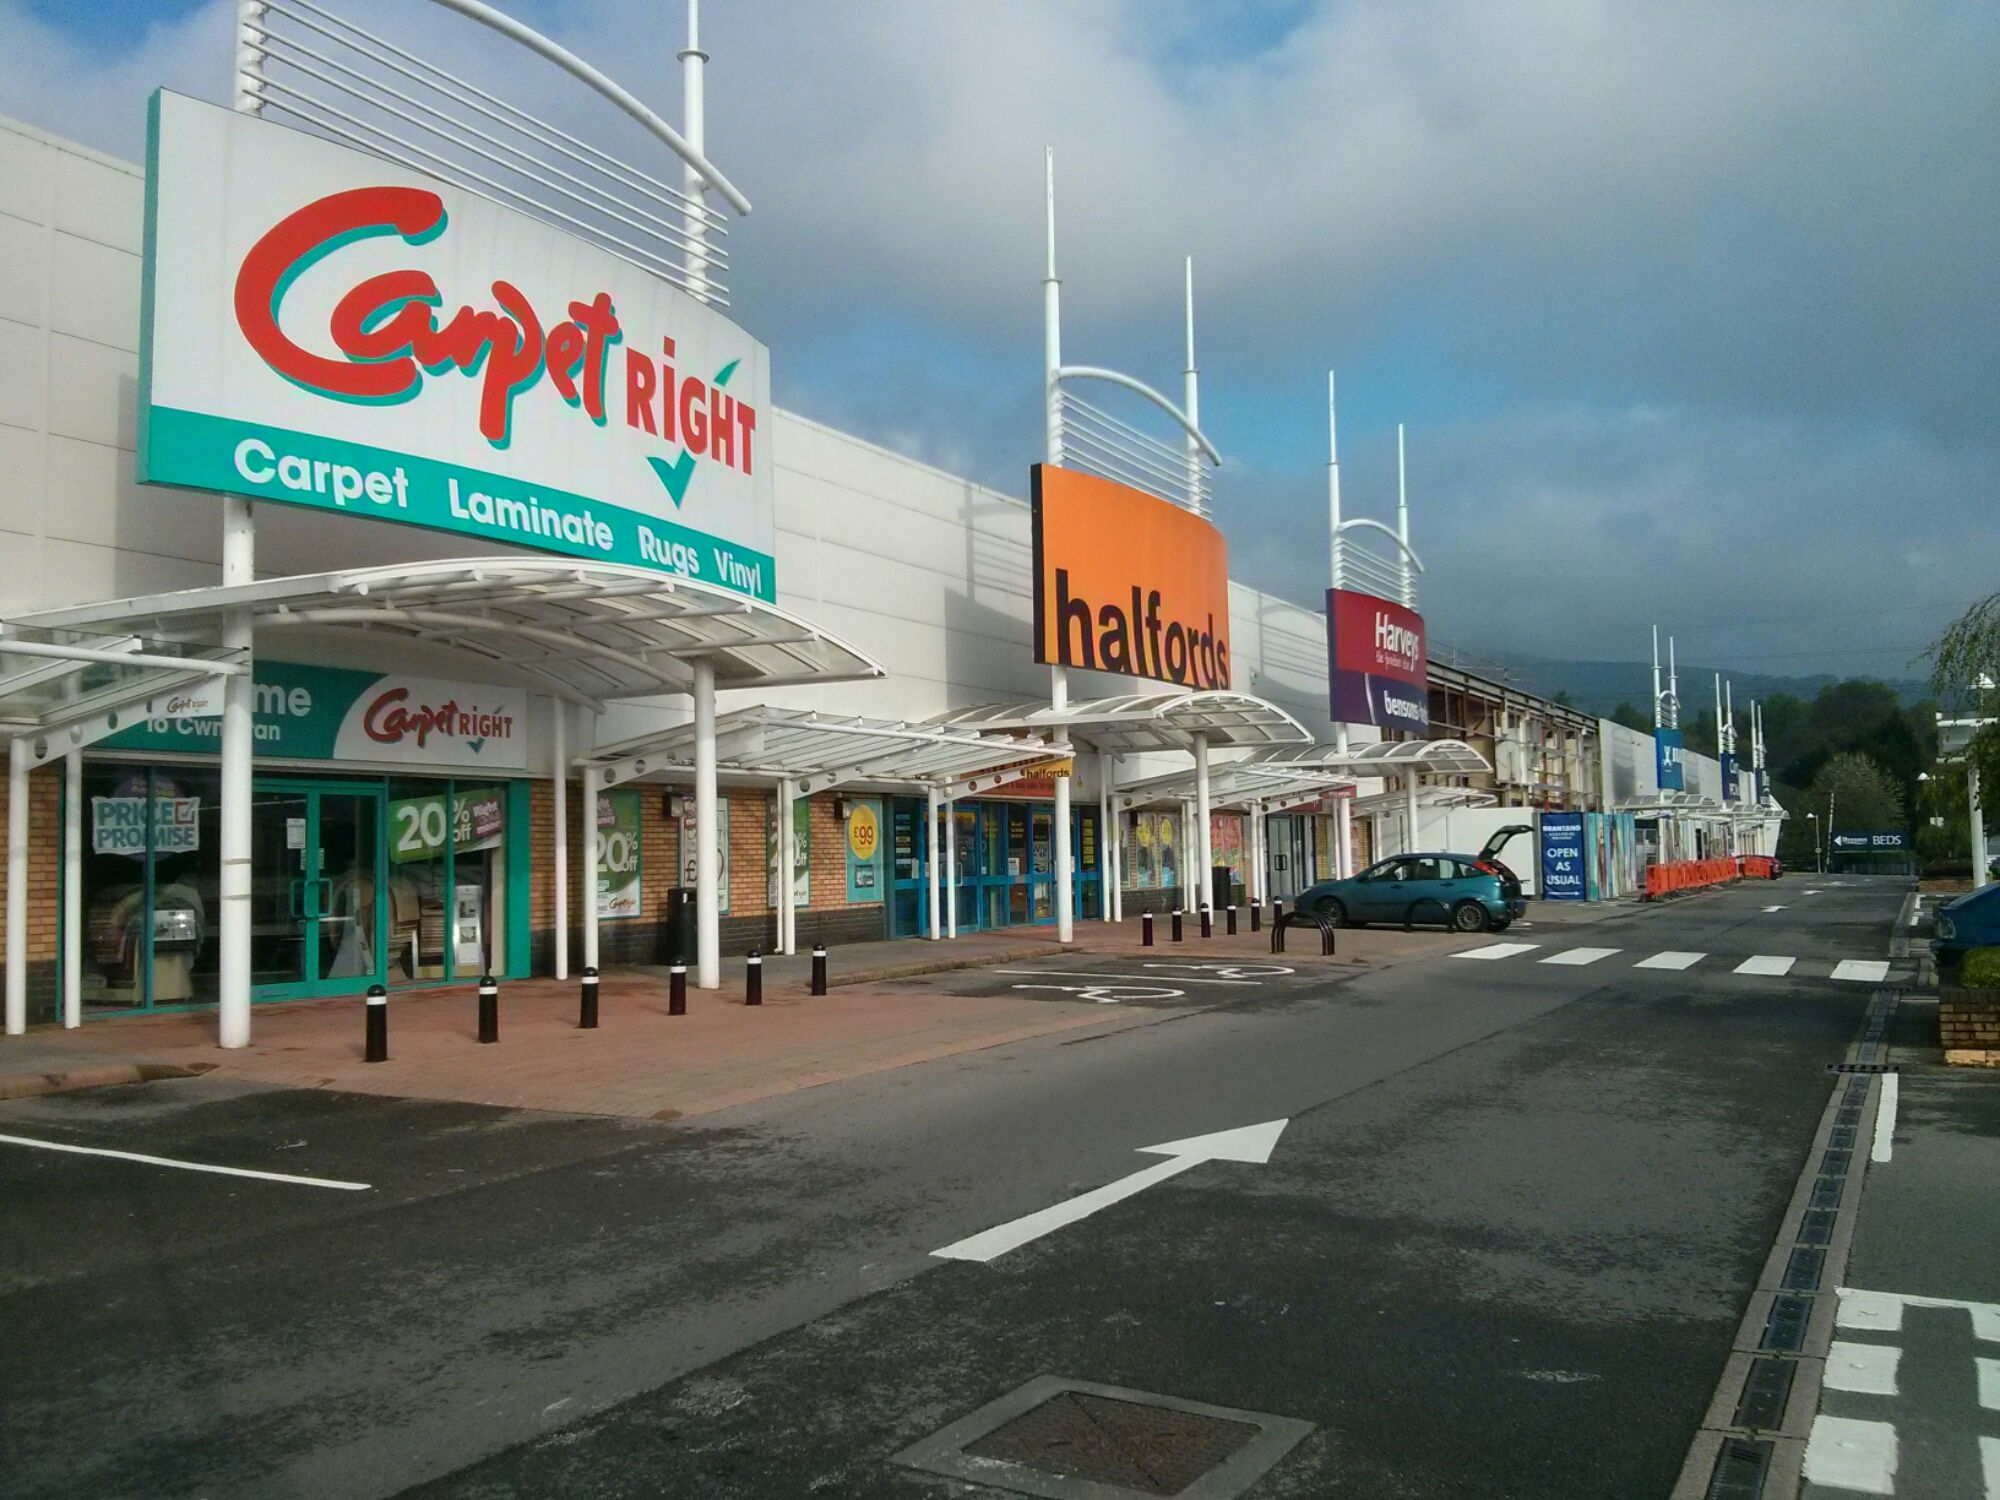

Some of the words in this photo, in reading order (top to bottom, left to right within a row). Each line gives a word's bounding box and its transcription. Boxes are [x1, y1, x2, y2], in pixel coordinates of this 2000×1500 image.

[234, 186, 622, 450] Carpet
[234, 438, 409, 508] Carpet
[448, 477, 614, 552] Laminate
[637, 524, 700, 577] Rugs
[713, 547, 762, 598] Vinyl
[1055, 567, 1229, 690] halfords
[1375, 611, 1419, 672] Harveys
[1384, 690, 1419, 721] bensons
[364, 687, 458, 749] Carpet
[1026, 768, 1070, 779] halfords
[97, 826, 195, 849] PROMISE
[854, 825, 874, 845] £99
[1873, 835, 1902, 845] BEDS
[1547, 848, 1578, 858] OPEN
[1555, 861, 1571, 871] AS
[1546, 875, 1581, 885] USUAL
